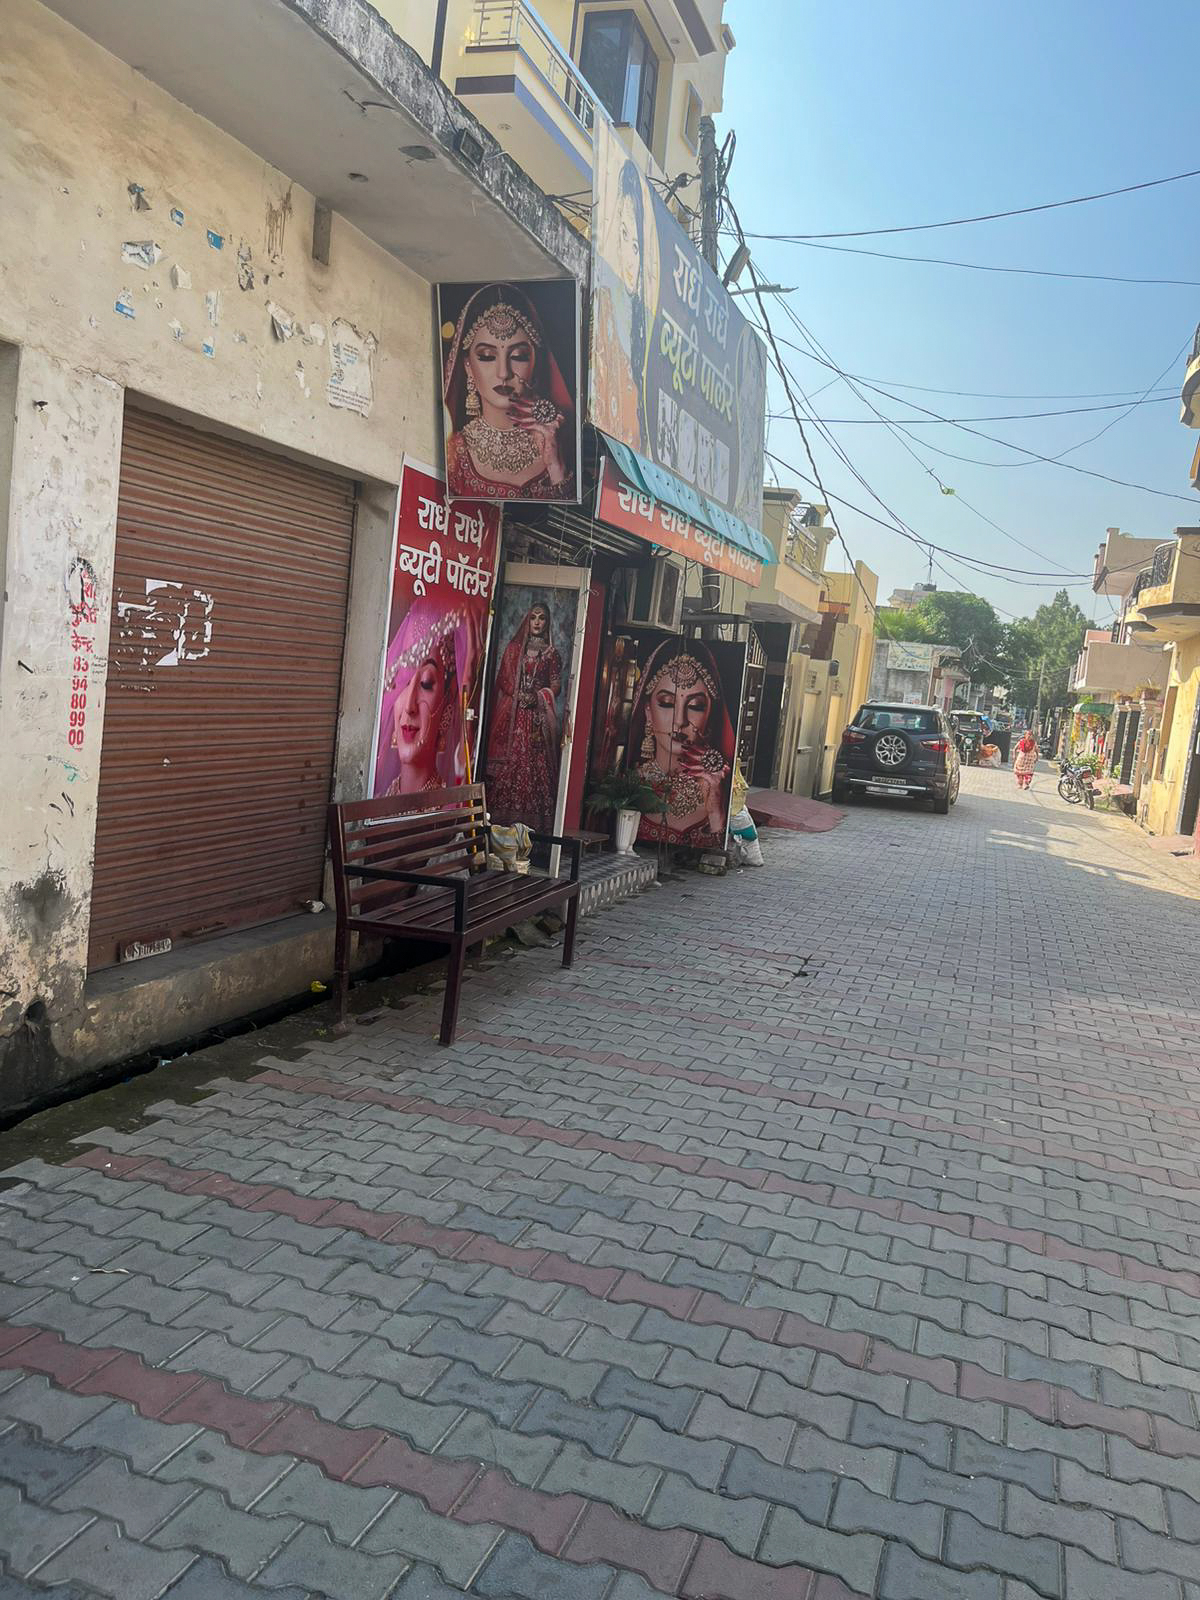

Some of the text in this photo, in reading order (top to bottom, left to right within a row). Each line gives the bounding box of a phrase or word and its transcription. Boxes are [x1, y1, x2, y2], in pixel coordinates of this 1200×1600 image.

[673, 243, 729, 350] राधे राधे
[660, 308, 735, 422] ब्यूटी पार्लर
[418, 495, 485, 549] राधे राधे
[618, 482, 657, 522] राध
[660, 504, 692, 540] राध
[399, 541, 442, 596] ब्यूटी
[69, 711, 86, 727] 99
[71, 693, 87, 710] 80
[68, 729, 84, 745] 00
